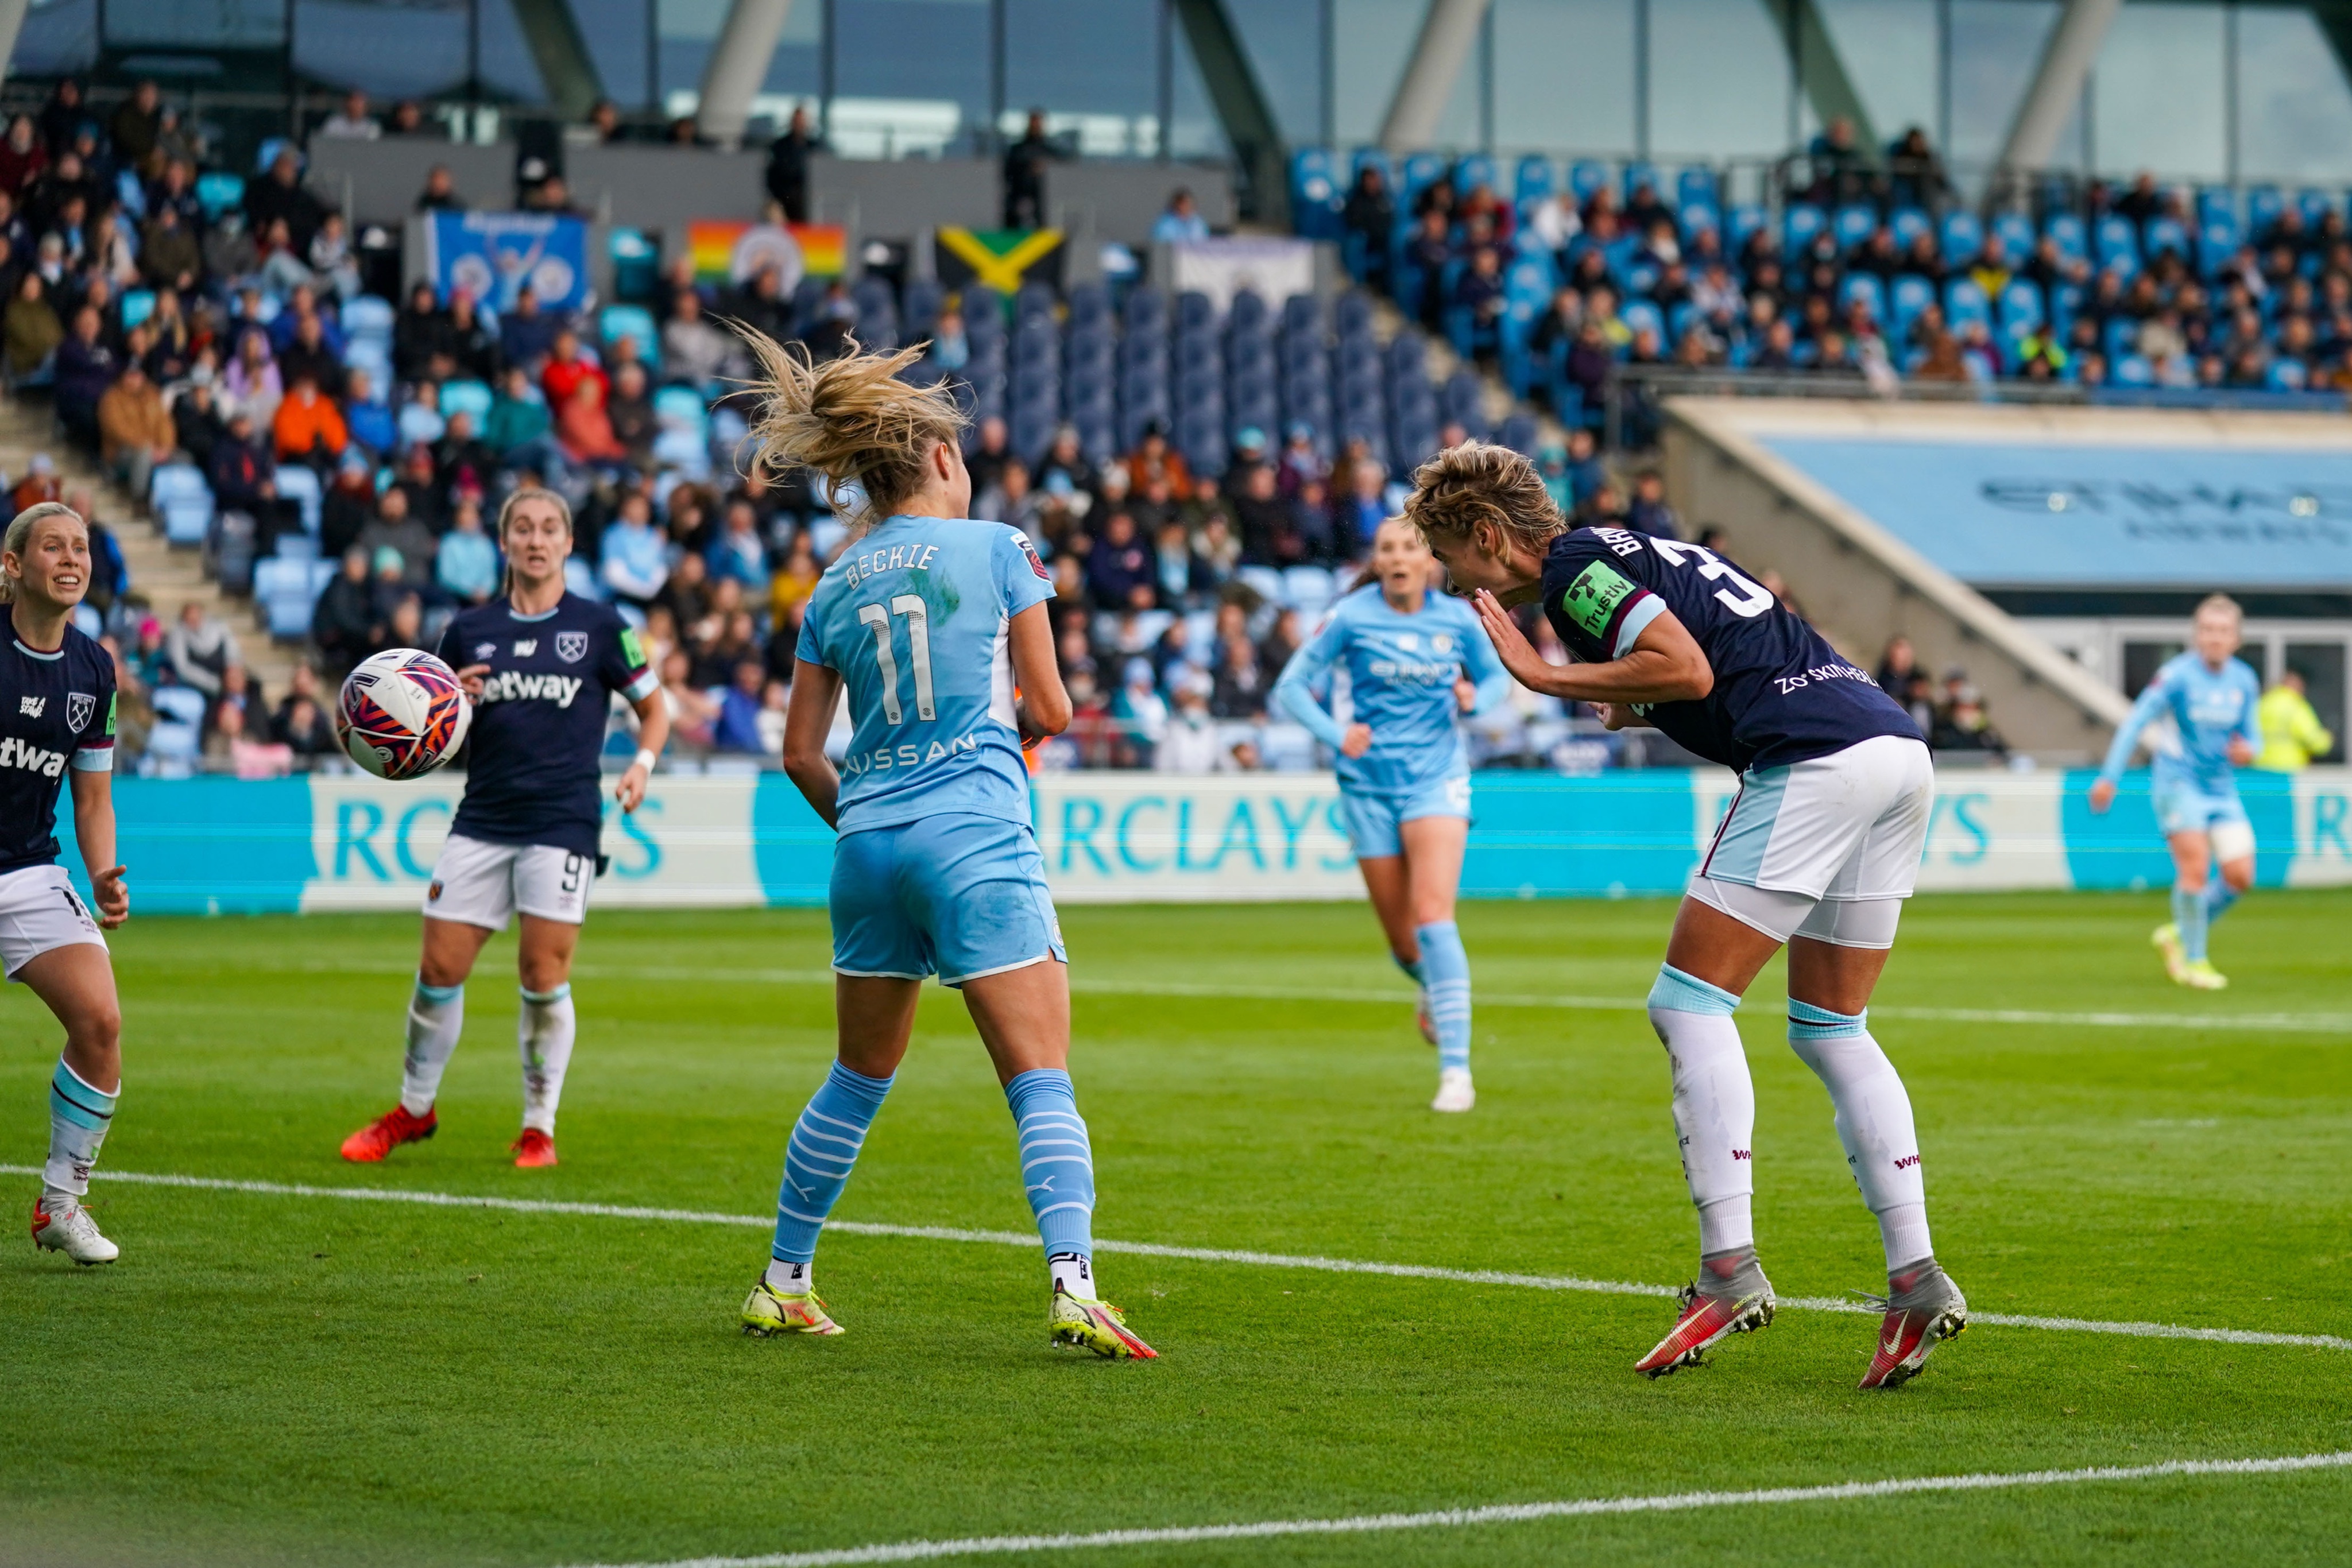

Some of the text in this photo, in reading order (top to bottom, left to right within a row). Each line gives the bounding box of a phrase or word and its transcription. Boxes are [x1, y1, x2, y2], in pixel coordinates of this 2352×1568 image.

[845, 543, 940, 591] BECKIE
[1649, 536, 1774, 618] 3
[1584, 580, 1628, 630] Trustly
[857, 593, 938, 726] 11
[479, 670, 583, 709] etway
[0, 737, 68, 785] twa
[843, 732, 977, 778] NISSAN
[562, 853, 581, 892] 9
